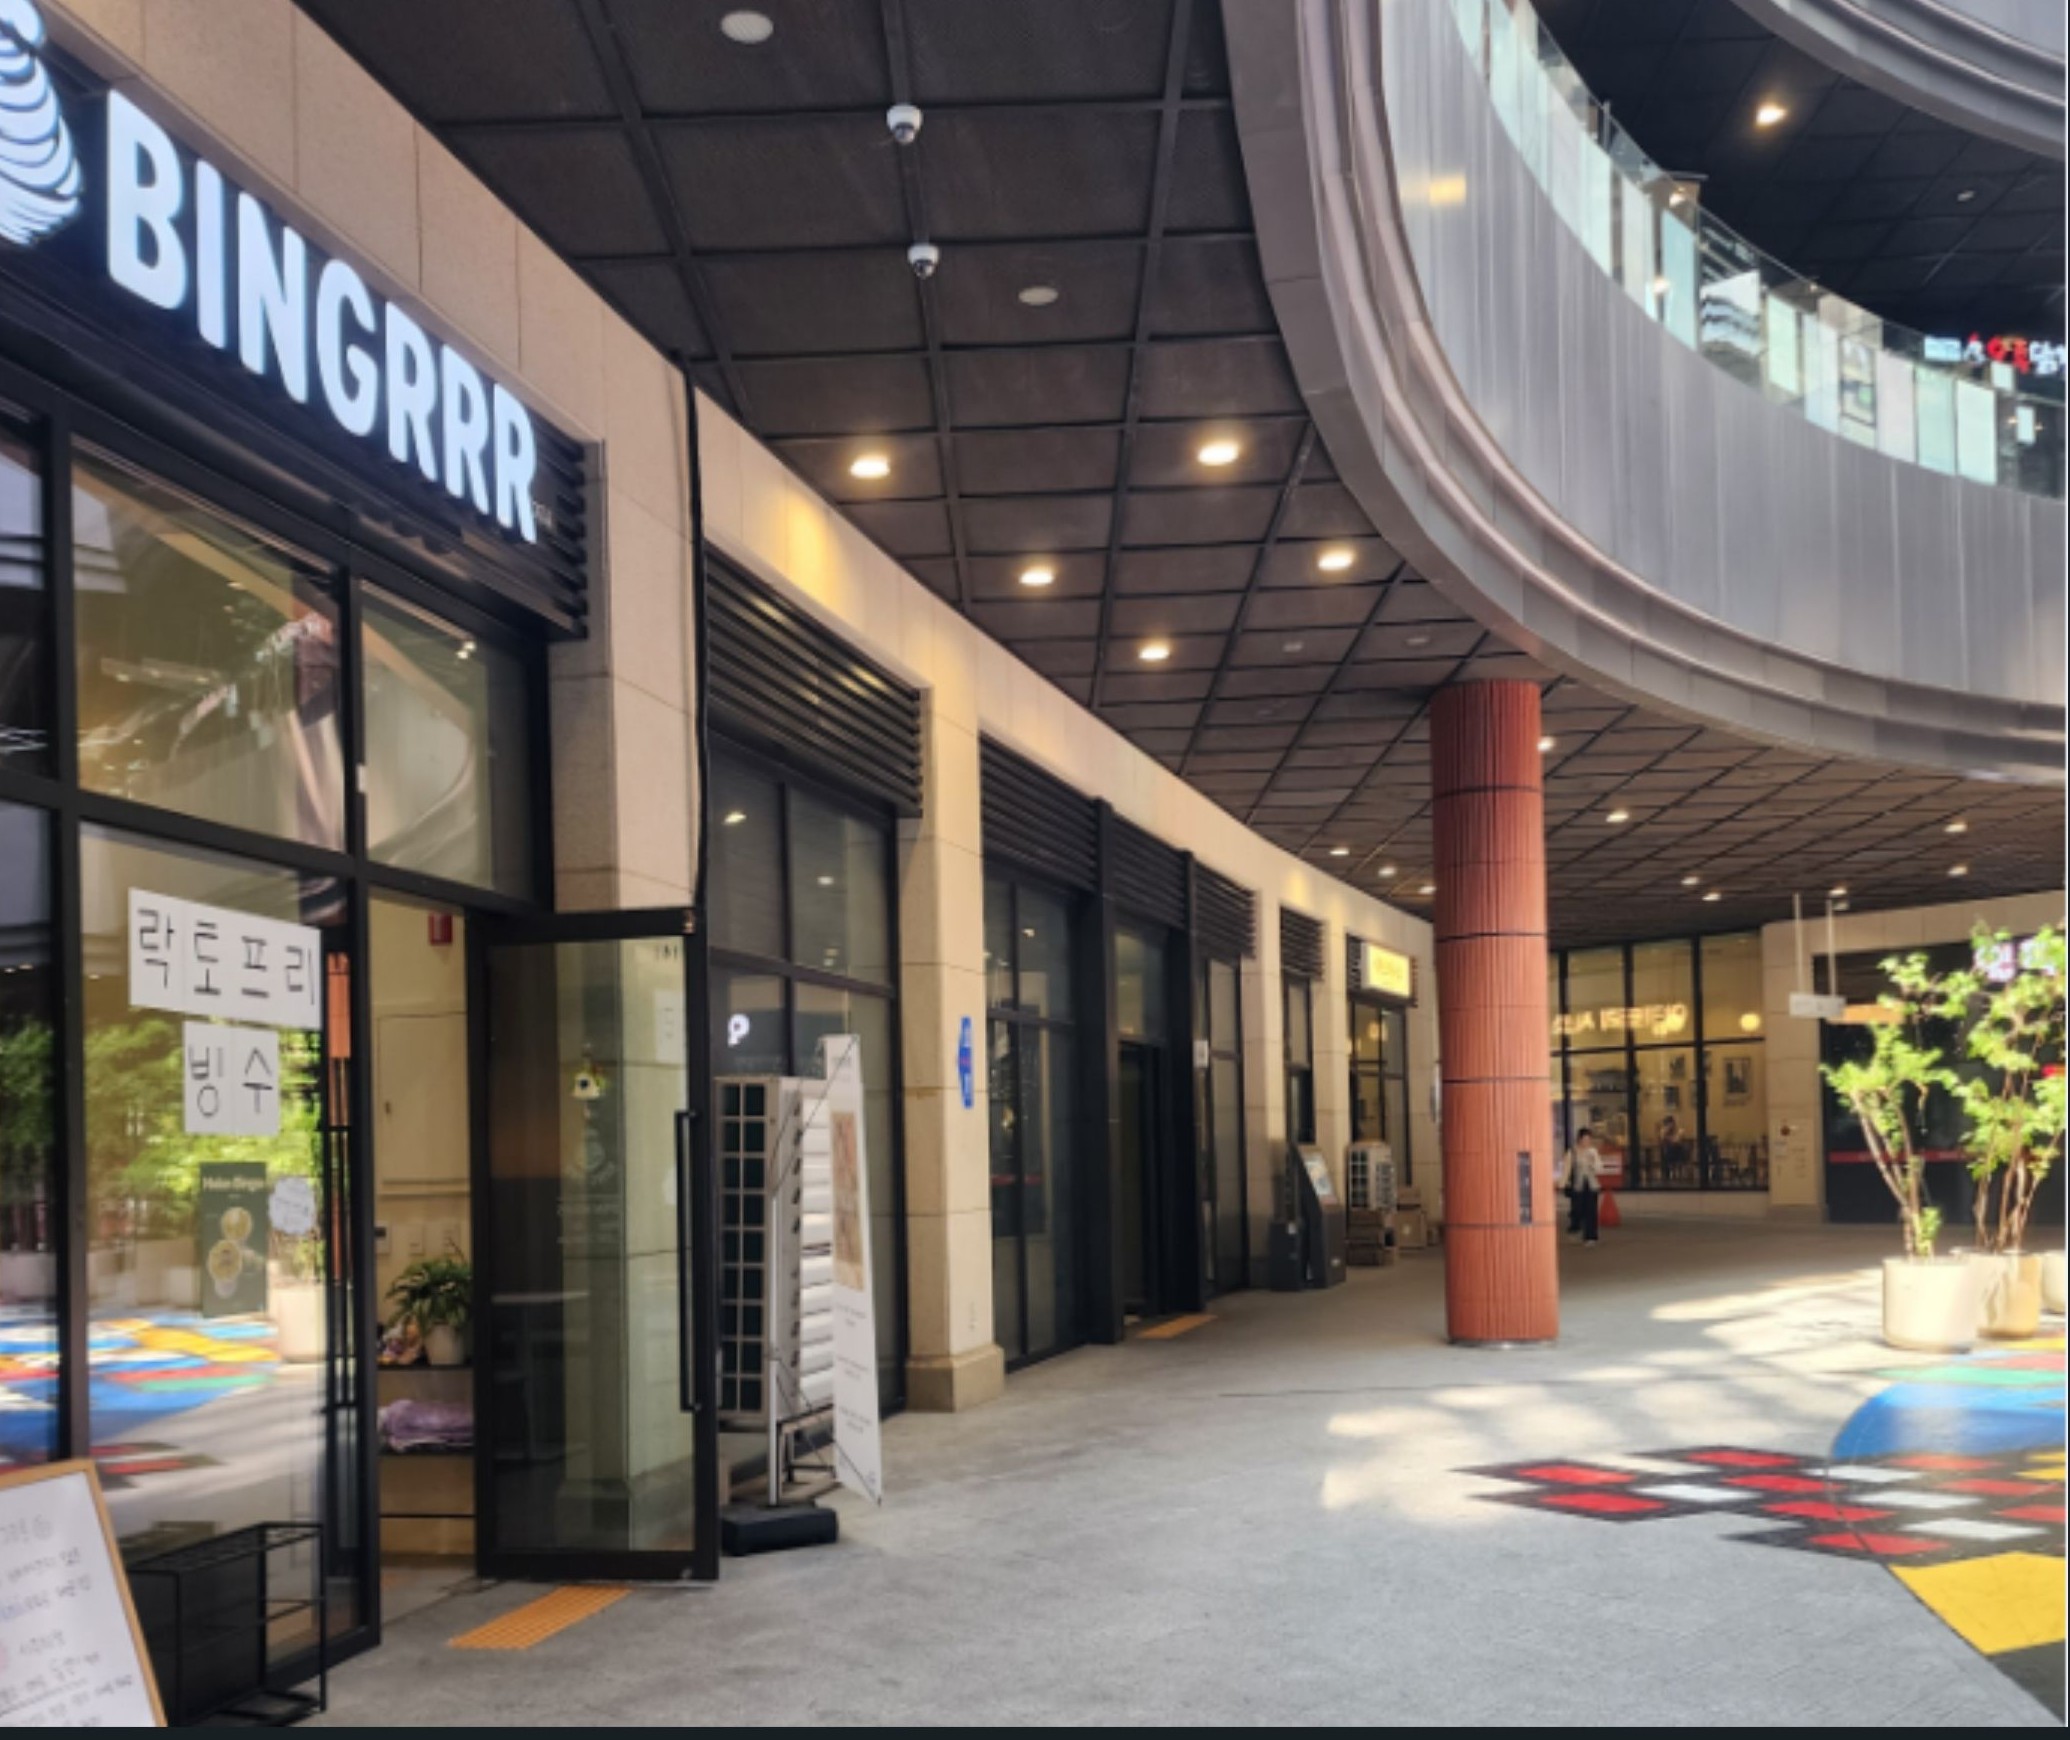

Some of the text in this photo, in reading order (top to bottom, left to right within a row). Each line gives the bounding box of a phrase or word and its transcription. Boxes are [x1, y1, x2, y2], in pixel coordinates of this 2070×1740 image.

[106, 88, 539, 544] BINGRRR
[137, 907, 316, 1006] 락토프리
[188, 1044, 274, 1118] 빙수
